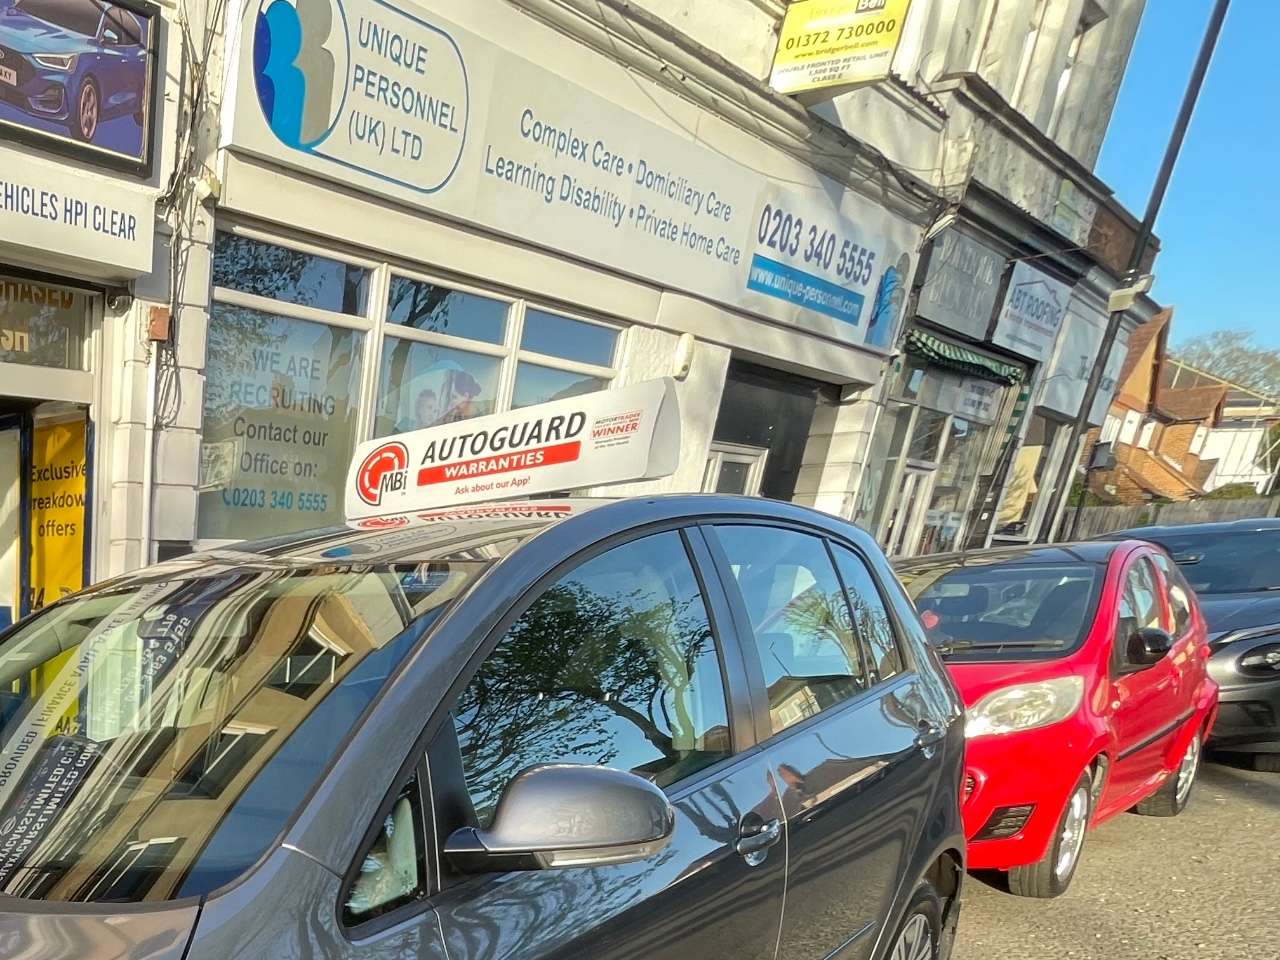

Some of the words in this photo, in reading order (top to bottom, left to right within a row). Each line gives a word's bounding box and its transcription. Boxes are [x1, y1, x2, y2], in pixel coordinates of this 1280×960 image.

[358, 18, 429, 75] UNIQUE
[785, 31, 830, 50] 01372
[836, 19, 896, 41] 730000
[352, 64, 459, 134] PERSONNEL
[348, 110, 387, 156] (UK)
[391, 127, 424, 161] LTD
[520, 108, 590, 163] Complex
[592, 140, 624, 177] Care
[635, 159, 705, 215] Domiciliary
[706, 191, 732, 222] Care
[63, 196, 88, 228] HPI
[92, 205, 137, 242] CLEAR
[484, 145, 557, 204] Learning
[559, 174, 626, 228] Disability
[635, 204, 678, 242] Private
[681, 222, 714, 256] Home
[715, 236, 741, 266] Care
[758, 203, 803, 257] 0203
[804, 224, 837, 271] 340
[836, 239, 876, 287] 5555
[253, 347, 281, 372] WE
[286, 355, 321, 381] ARE
[230, 380, 336, 417] RECRUITING
[234, 416, 298, 444] Contact
[302, 429, 329, 448] our
[420, 410, 587, 465] AUTOGUARD
[592, 422, 638, 438] WINNER
[31, 459, 86, 482] Exclusive
[240, 451, 289, 475] Office
[293, 461, 318, 478] on:
[444, 450, 545, 478] WARRANTIES
[380, 470, 408, 493] MBi
[454, 484, 469, 495] Ask
[471, 482, 494, 493] about
[496, 480, 509, 489] our
[510, 476, 531, 490] App!
[31, 490, 84, 510] reakdow
[232, 487, 266, 509] 0203
[270, 491, 294, 510] 340
[298, 492, 328, 513] 5555
[38, 519, 76, 538] offers
